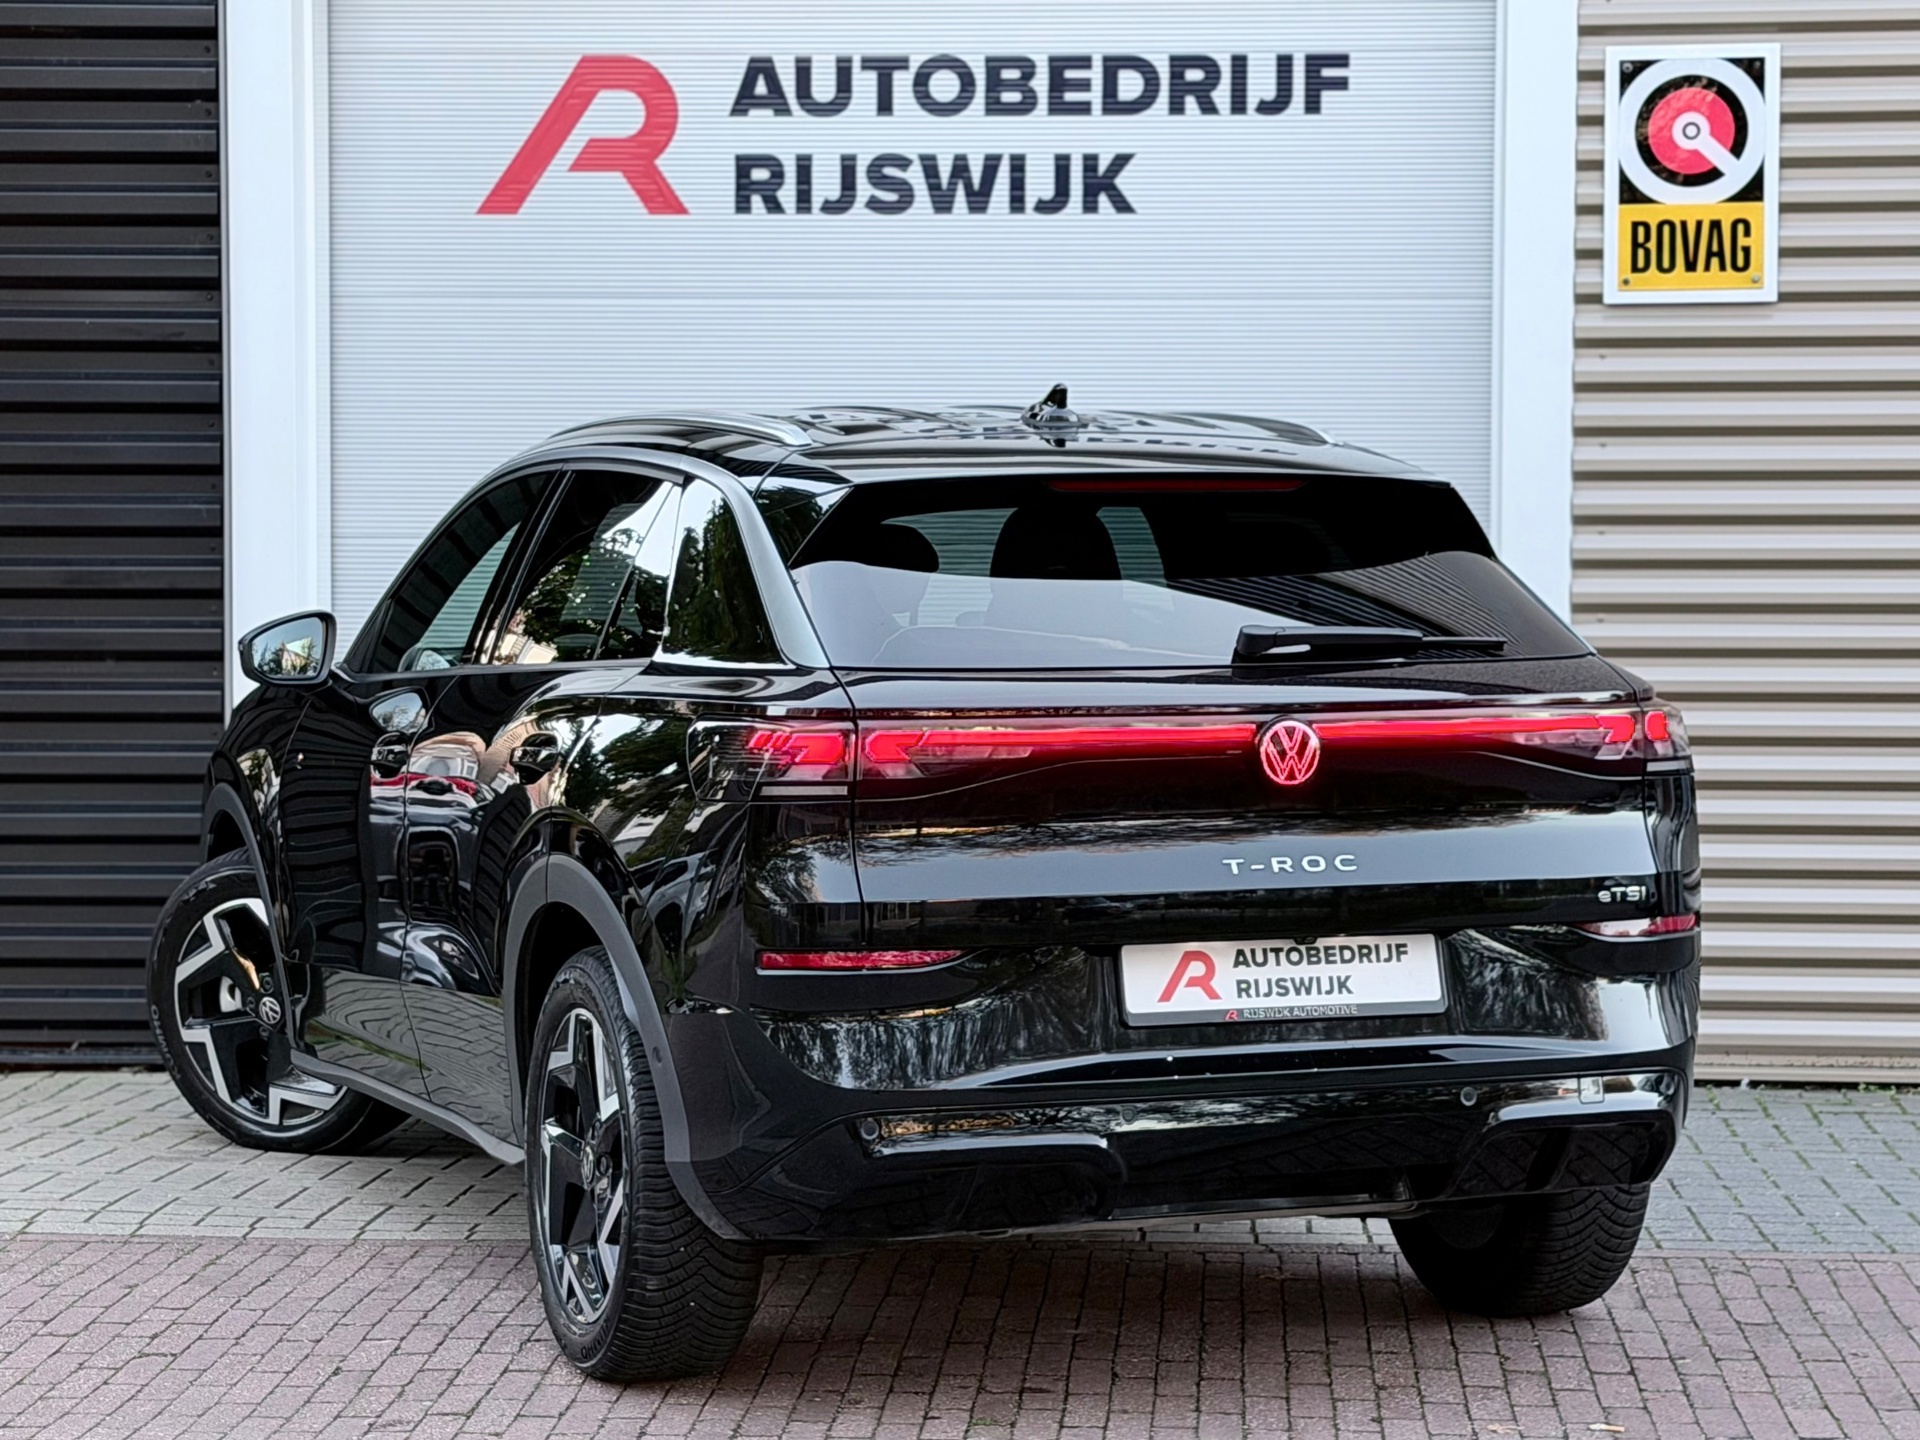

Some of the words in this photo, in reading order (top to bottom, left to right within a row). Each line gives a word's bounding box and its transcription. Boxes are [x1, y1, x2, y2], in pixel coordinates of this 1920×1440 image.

[729, 53, 1350, 117] AUTOBEDRIJF
[734, 152, 1138, 215] RIJSWIJK
[1631, 217, 1752, 274] BOVAG
[1222, 854, 1358, 875] T-ROC
[1597, 885, 1646, 903] eTSI
[1232, 943, 1409, 969] AUTOBEDRIJF
[1235, 975, 1355, 999] RIJSWIJK
[1243, 1007, 1291, 1019] RIJSWIJK
[1293, 1004, 1358, 1017] AUTOMOTIVE
